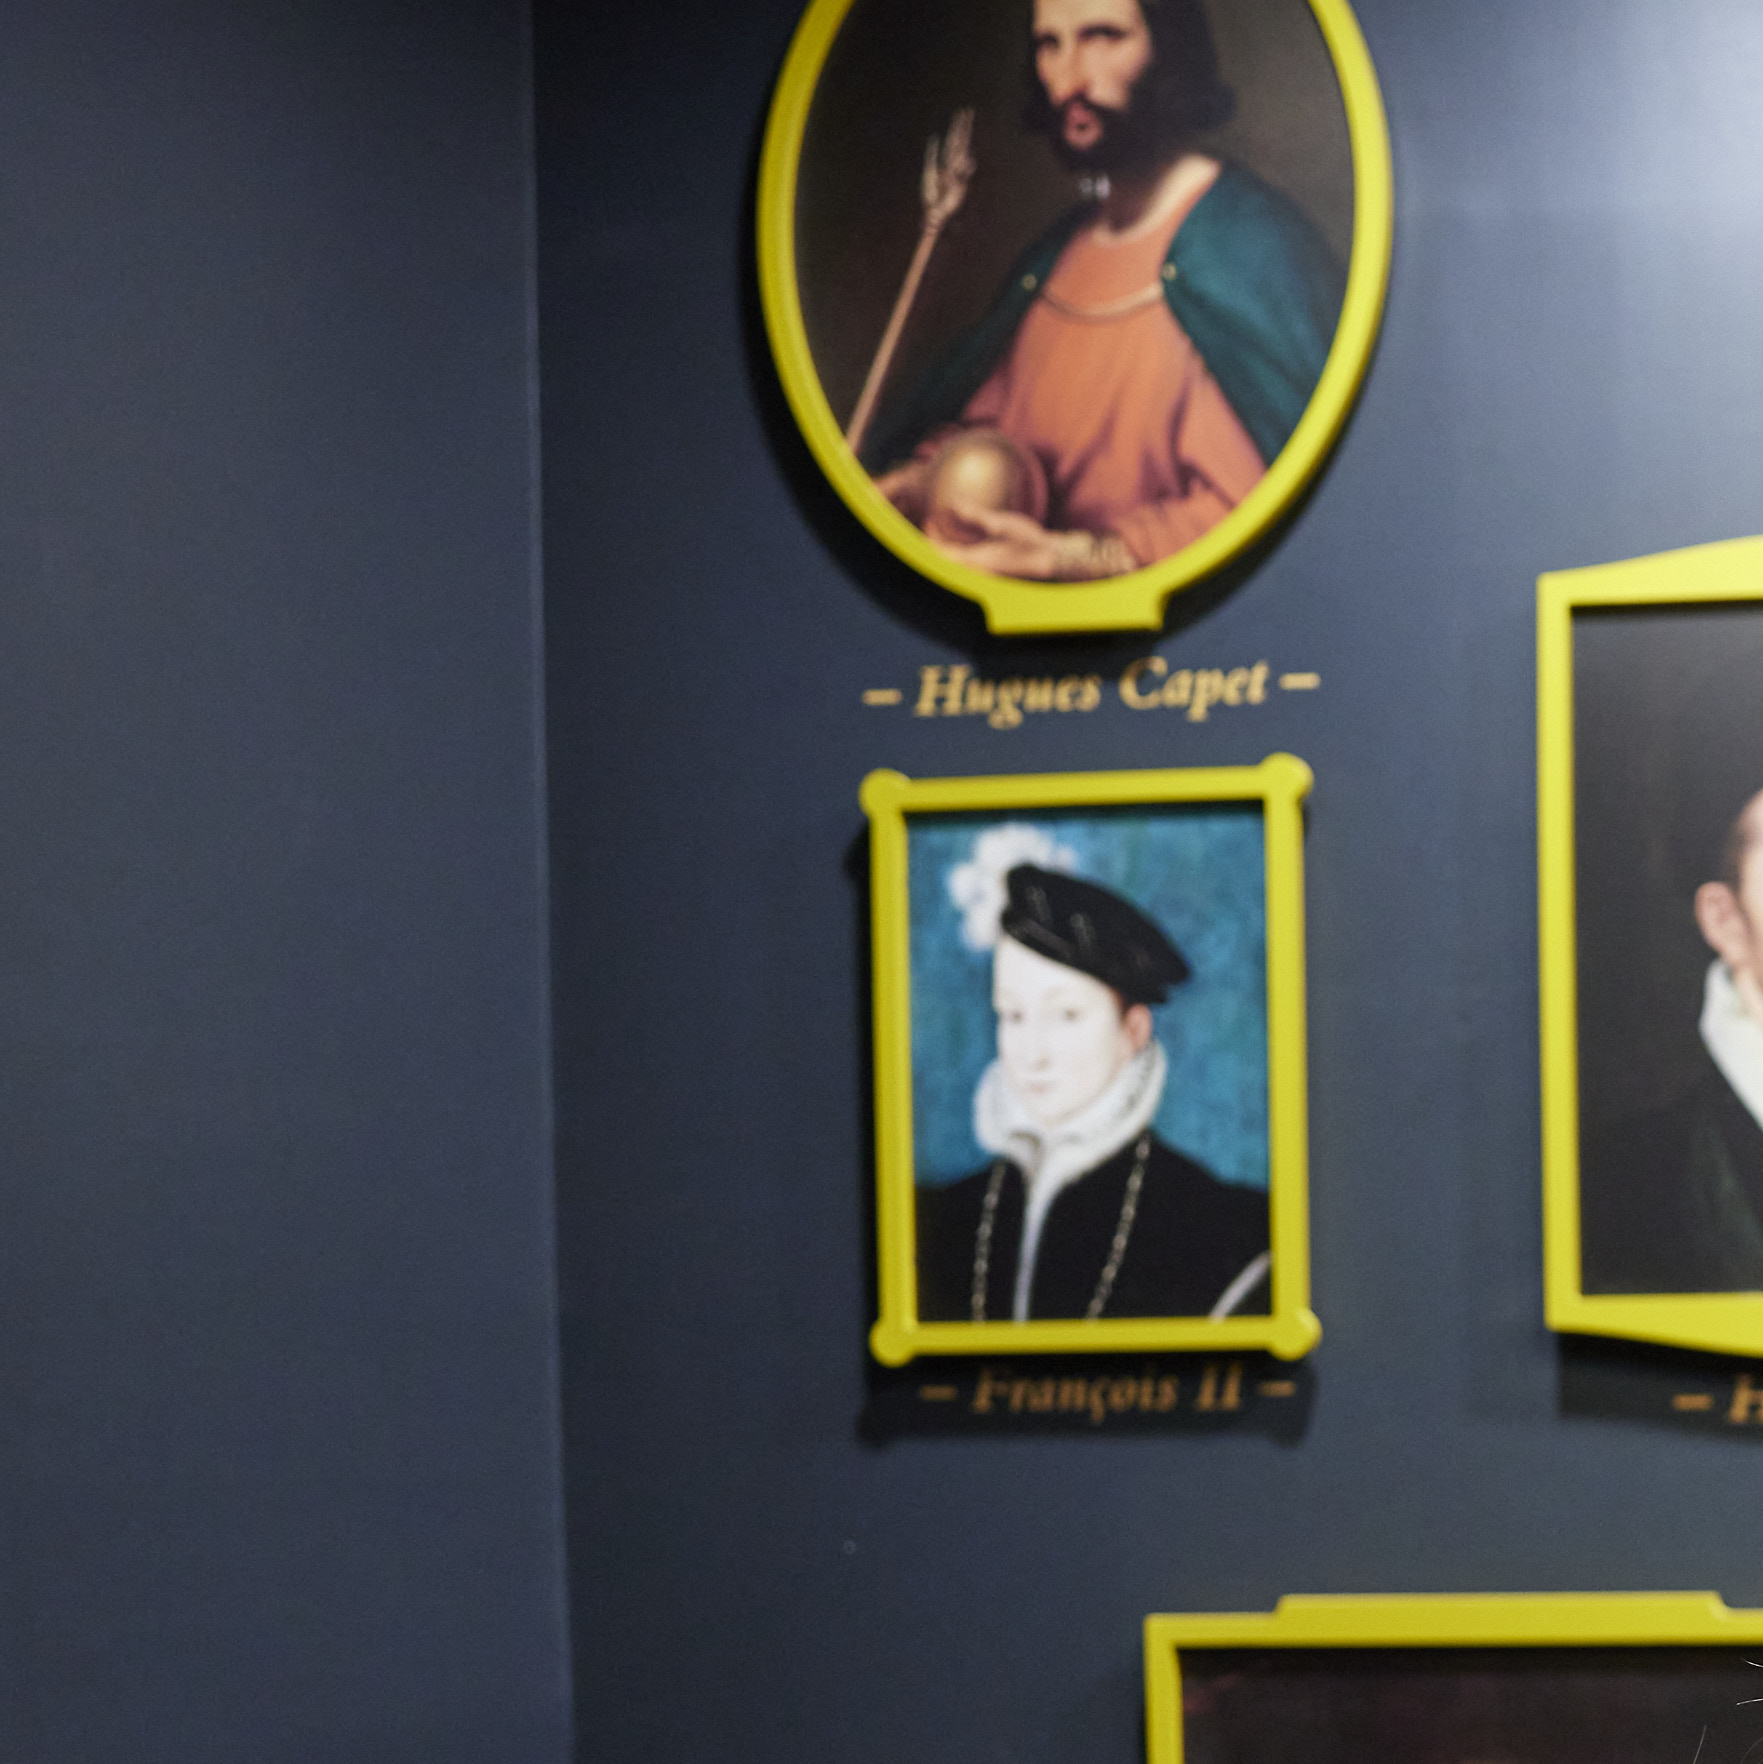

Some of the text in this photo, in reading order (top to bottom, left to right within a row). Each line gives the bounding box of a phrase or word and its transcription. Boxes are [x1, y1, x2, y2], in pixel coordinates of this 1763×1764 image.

[914, 655, 1269, 729] Hugues Capet
[1198, 1361, 1242, 1413] II
